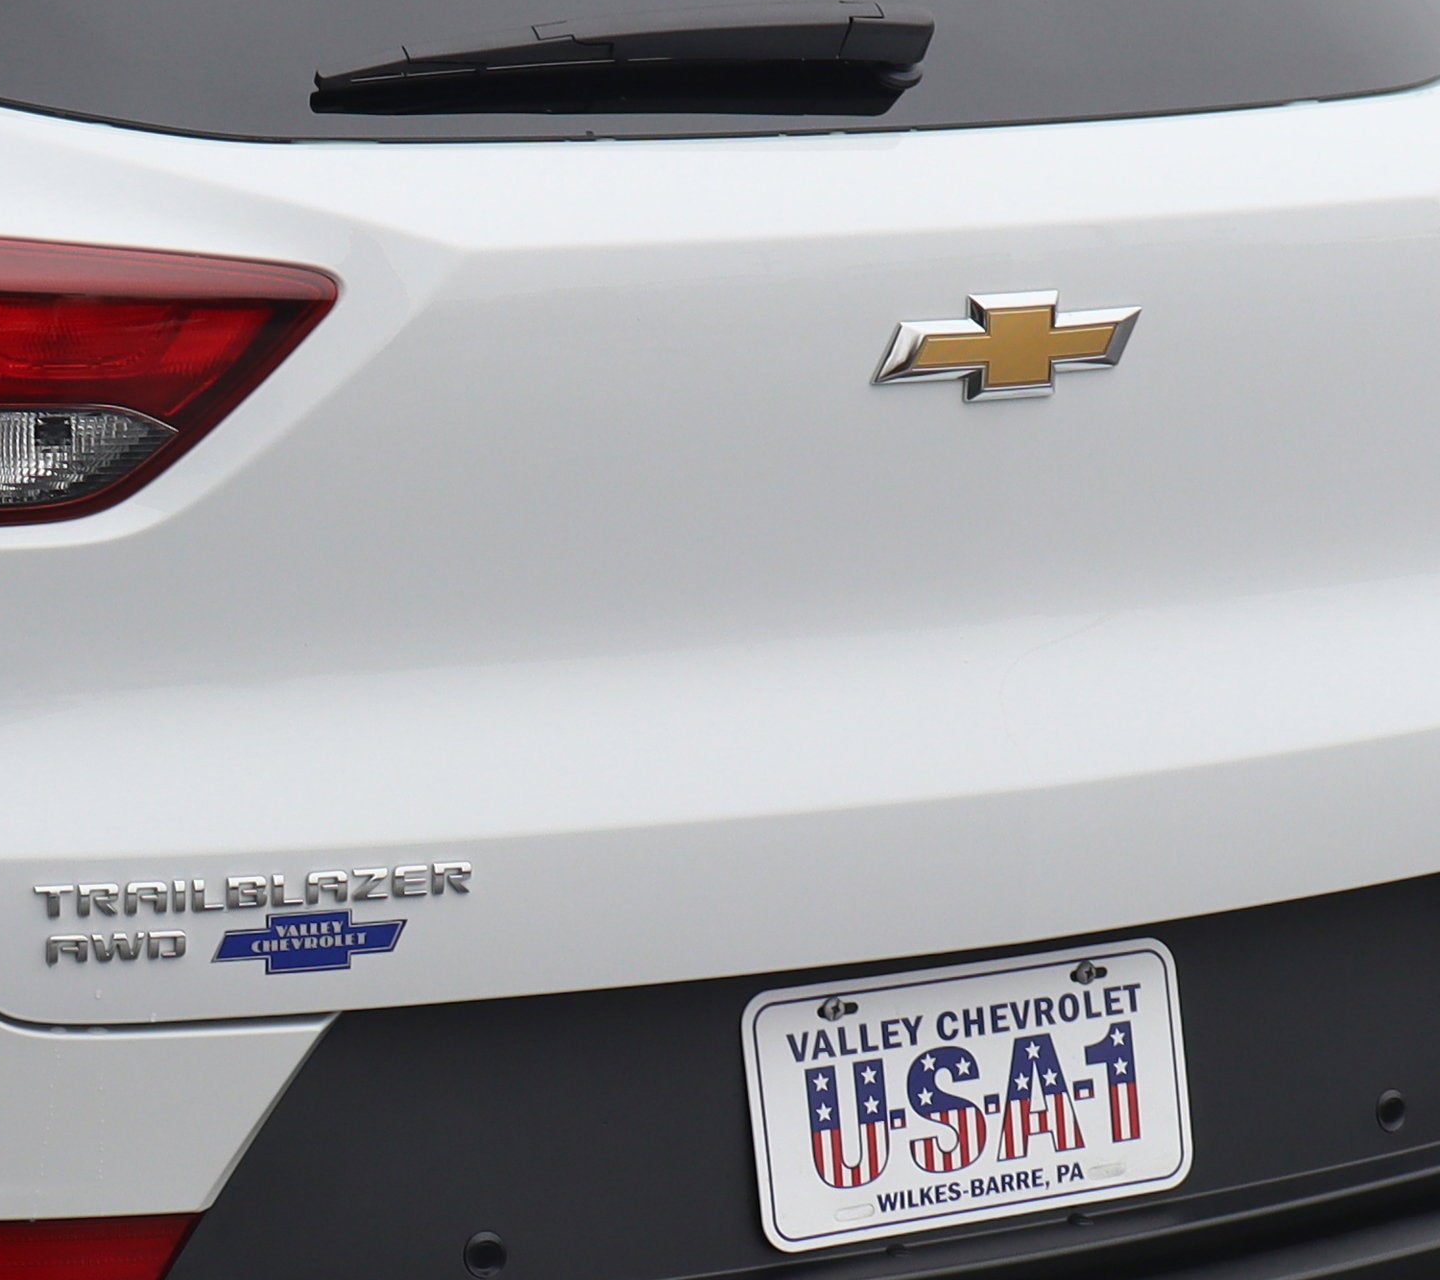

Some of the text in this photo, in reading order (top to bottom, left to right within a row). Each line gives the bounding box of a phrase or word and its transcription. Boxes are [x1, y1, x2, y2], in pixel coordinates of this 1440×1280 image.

[33, 860, 472, 920] TRAILBLAZER
[45, 928, 188, 967] AWD
[251, 931, 368, 955] CHEVROLET
[275, 920, 343, 939] VALLEY
[786, 982, 1142, 1063] VALLEY CHEVROLET
[876, 1162, 1085, 1213] WILKES-BARRE, PA
